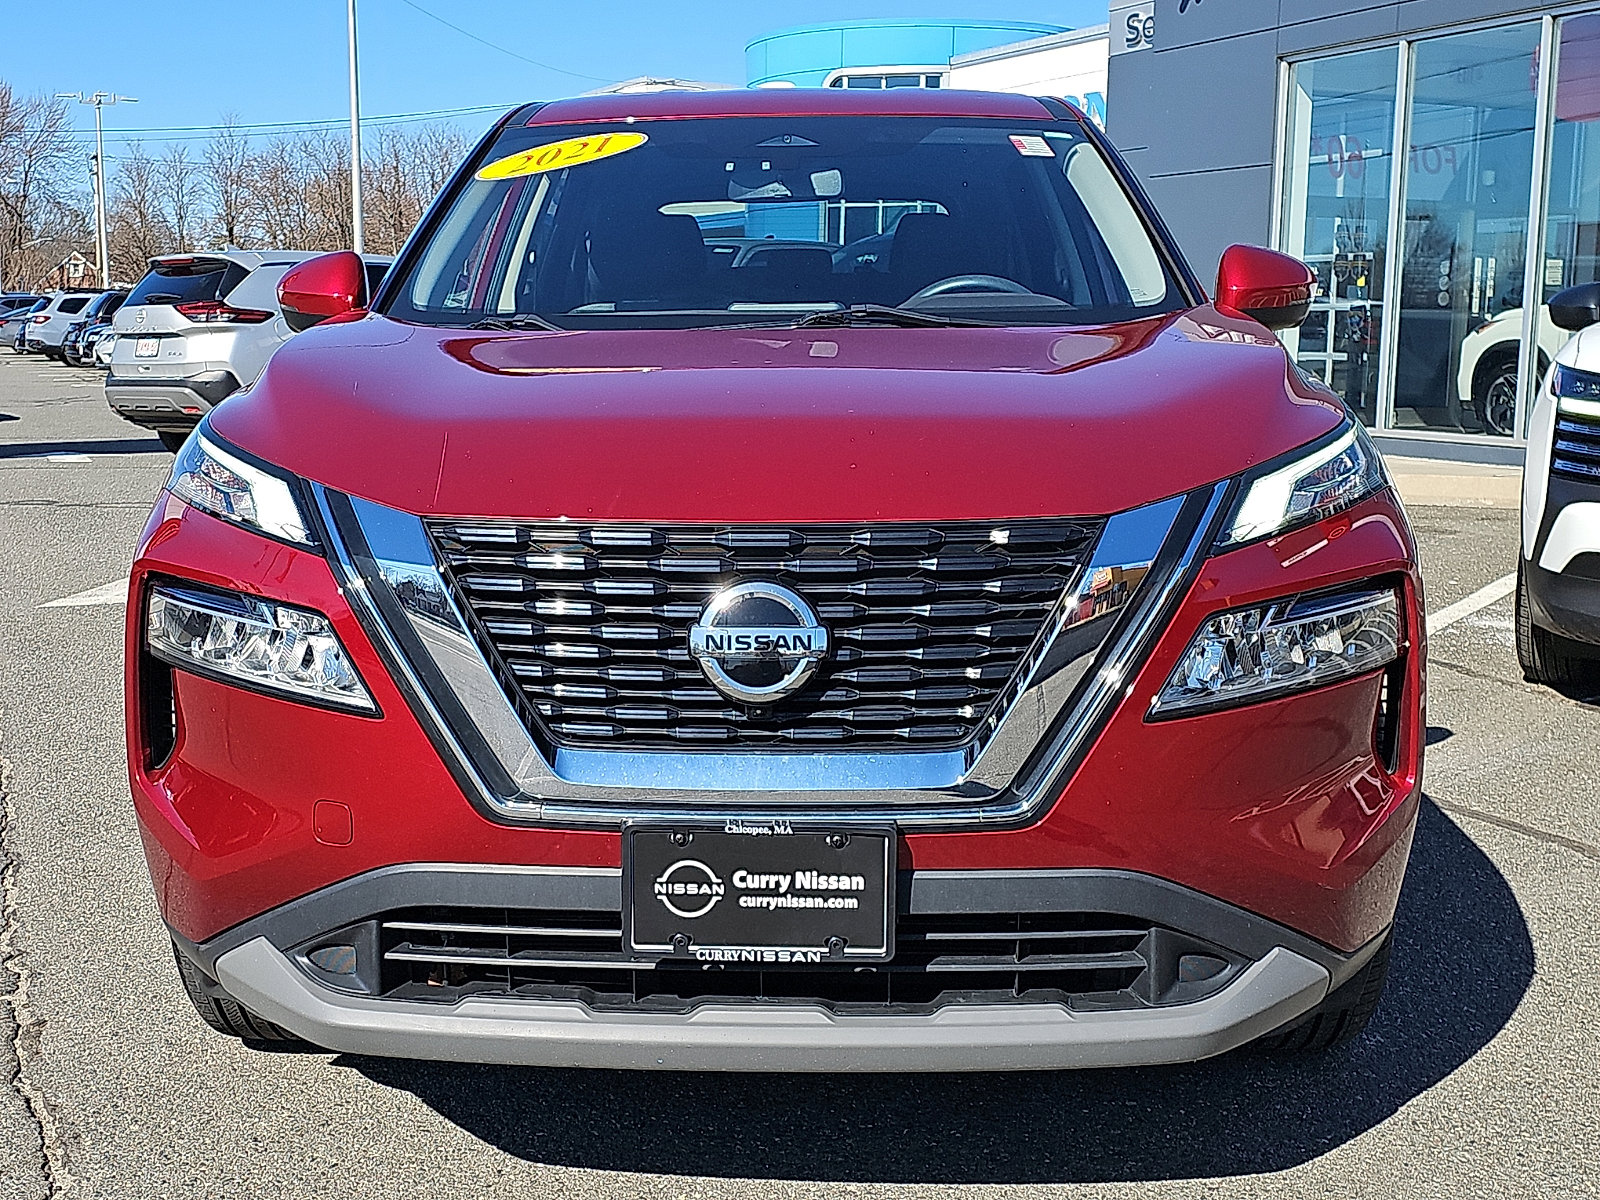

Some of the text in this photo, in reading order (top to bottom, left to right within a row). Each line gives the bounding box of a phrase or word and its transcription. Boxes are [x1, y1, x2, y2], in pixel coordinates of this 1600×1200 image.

[506, 136, 613, 174] 2021
[704, 634, 812, 652] NISSAN
[773, 825, 794, 835] MA
[654, 882, 725, 896] NISSAN
[732, 870, 865, 893] Curry Nissan
[738, 894, 859, 910] currynissan.com
